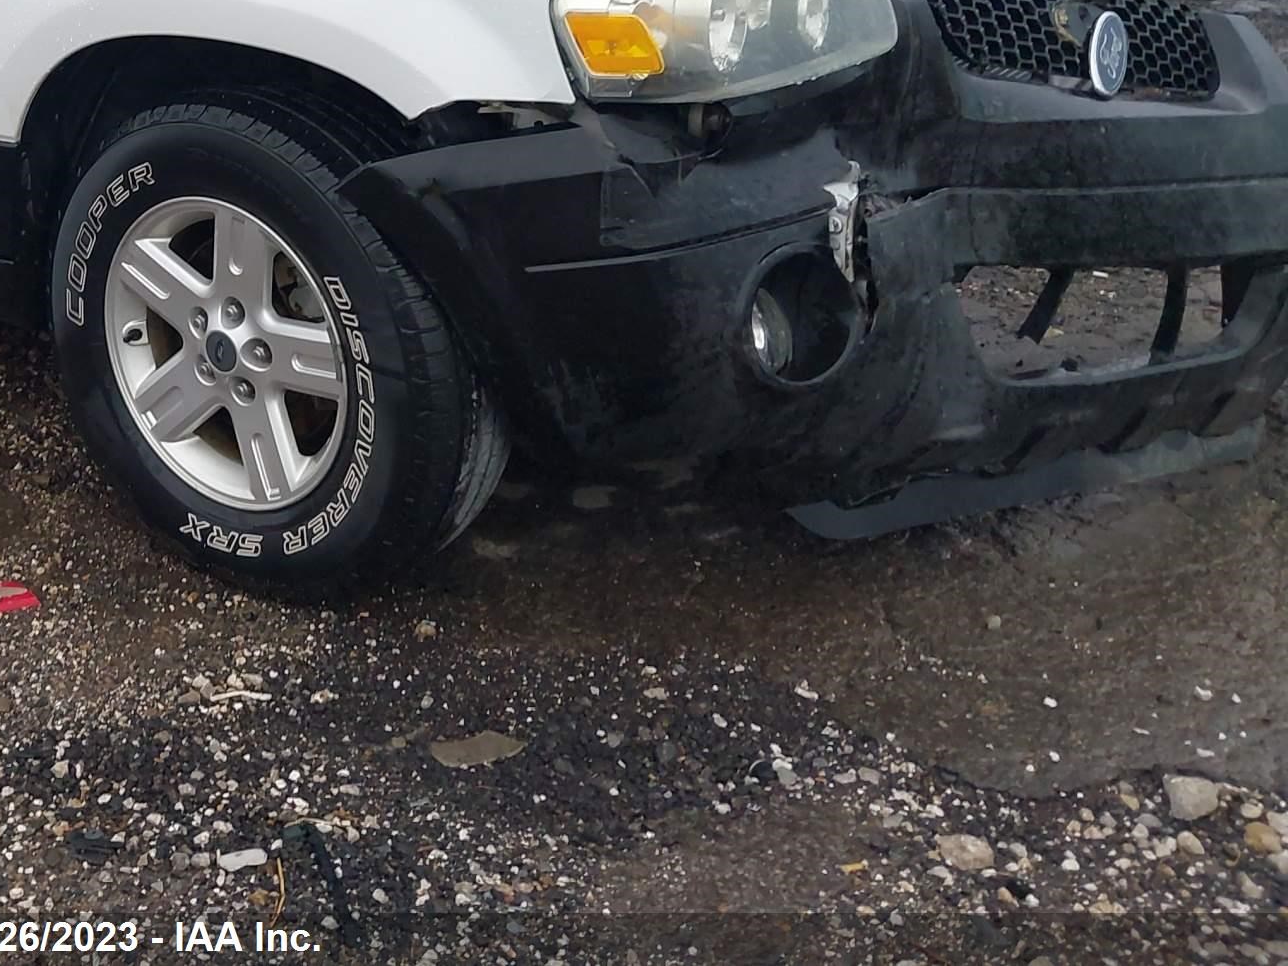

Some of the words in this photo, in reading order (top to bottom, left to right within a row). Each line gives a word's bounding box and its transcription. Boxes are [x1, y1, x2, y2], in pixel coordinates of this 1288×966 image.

[65, 161, 156, 327] COOPER
[283, 275, 376, 557] DISCOVERER
[179, 511, 264, 558] SRX
